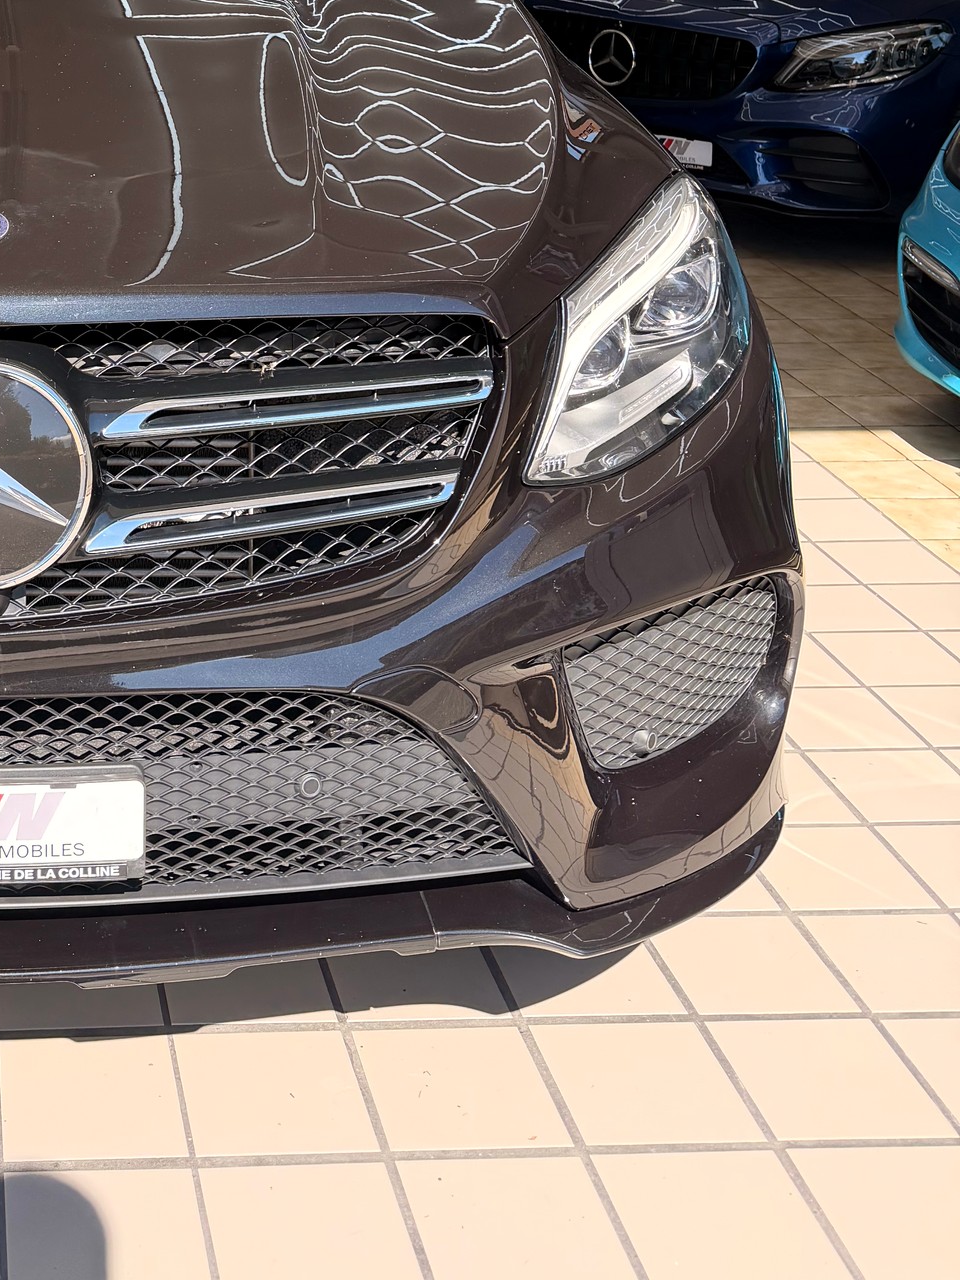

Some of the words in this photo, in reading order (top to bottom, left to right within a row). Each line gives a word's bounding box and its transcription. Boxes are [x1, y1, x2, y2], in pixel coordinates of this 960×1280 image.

[14, 869, 34, 880] DE
[37, 868, 56, 880] LA
[58, 865, 120, 879] COLLINE
